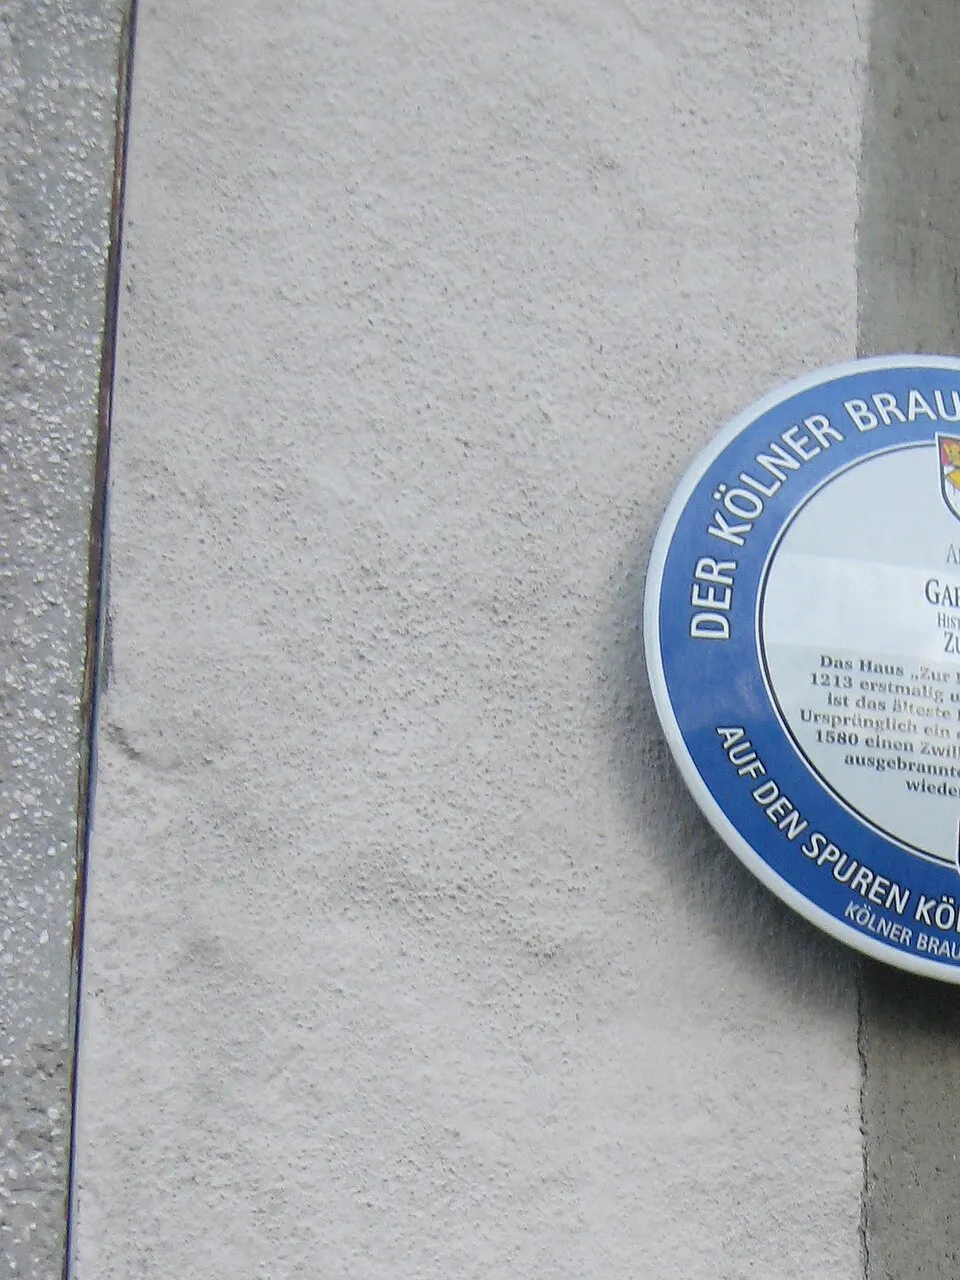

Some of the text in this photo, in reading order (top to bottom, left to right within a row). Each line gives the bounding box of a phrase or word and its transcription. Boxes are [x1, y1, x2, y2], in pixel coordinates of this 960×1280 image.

[707, 413, 846, 547] KÖLNER
[690, 557, 738, 640] DER
[820, 654, 853, 671] Das
[859, 658, 904, 677] Haus
[811, 671, 853, 689] 1213
[859, 679, 944, 704] erstmalig
[827, 692, 849, 708] ist
[855, 695, 886, 711] das
[800, 709, 918, 735] Ursprünglich
[923, 726, 951, 740] ein
[816, 729, 860, 747] 1580
[865, 734, 915, 753] einen
[717, 725, 766, 780] AUF
[752, 779, 809, 841] DEN
[801, 831, 911, 915] SPUREN
[844, 900, 913, 945] KÖLNER
